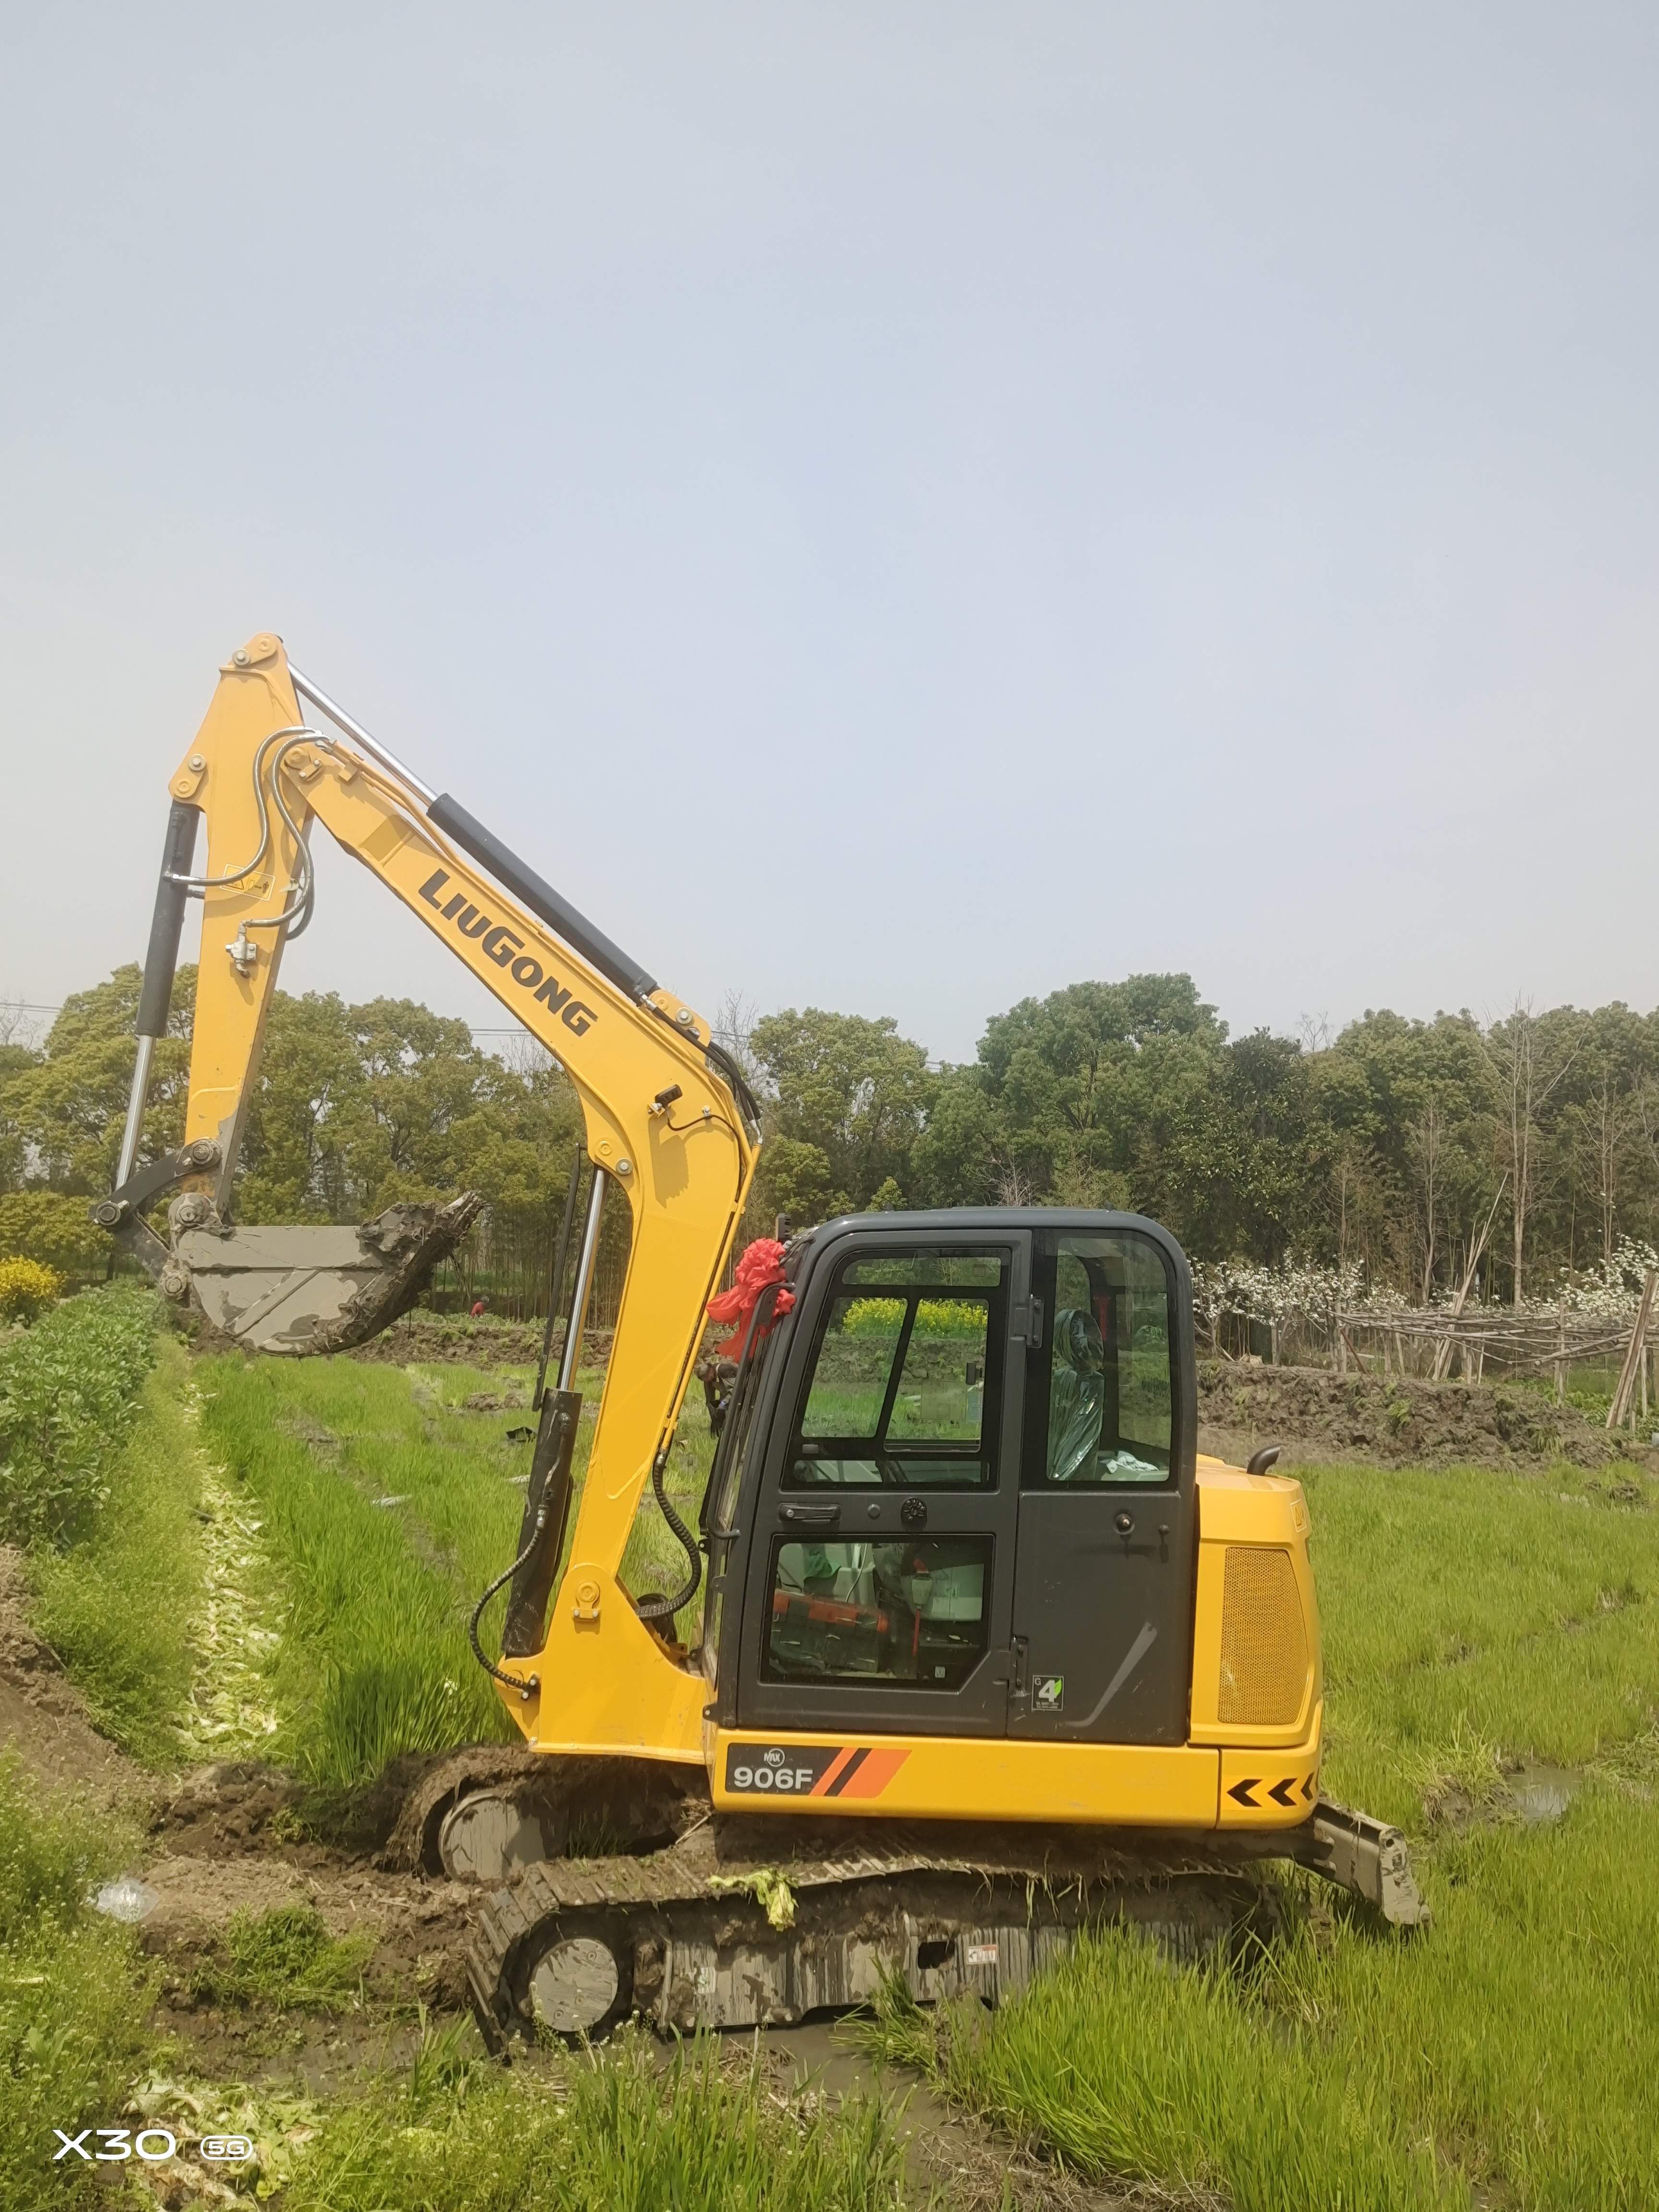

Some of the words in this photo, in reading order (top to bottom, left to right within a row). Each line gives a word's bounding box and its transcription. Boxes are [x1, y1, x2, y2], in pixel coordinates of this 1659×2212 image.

[419, 868, 599, 1037] LIUGONG
[1038, 1680, 1057, 1702] 4
[734, 1767, 813, 1790] 906F
